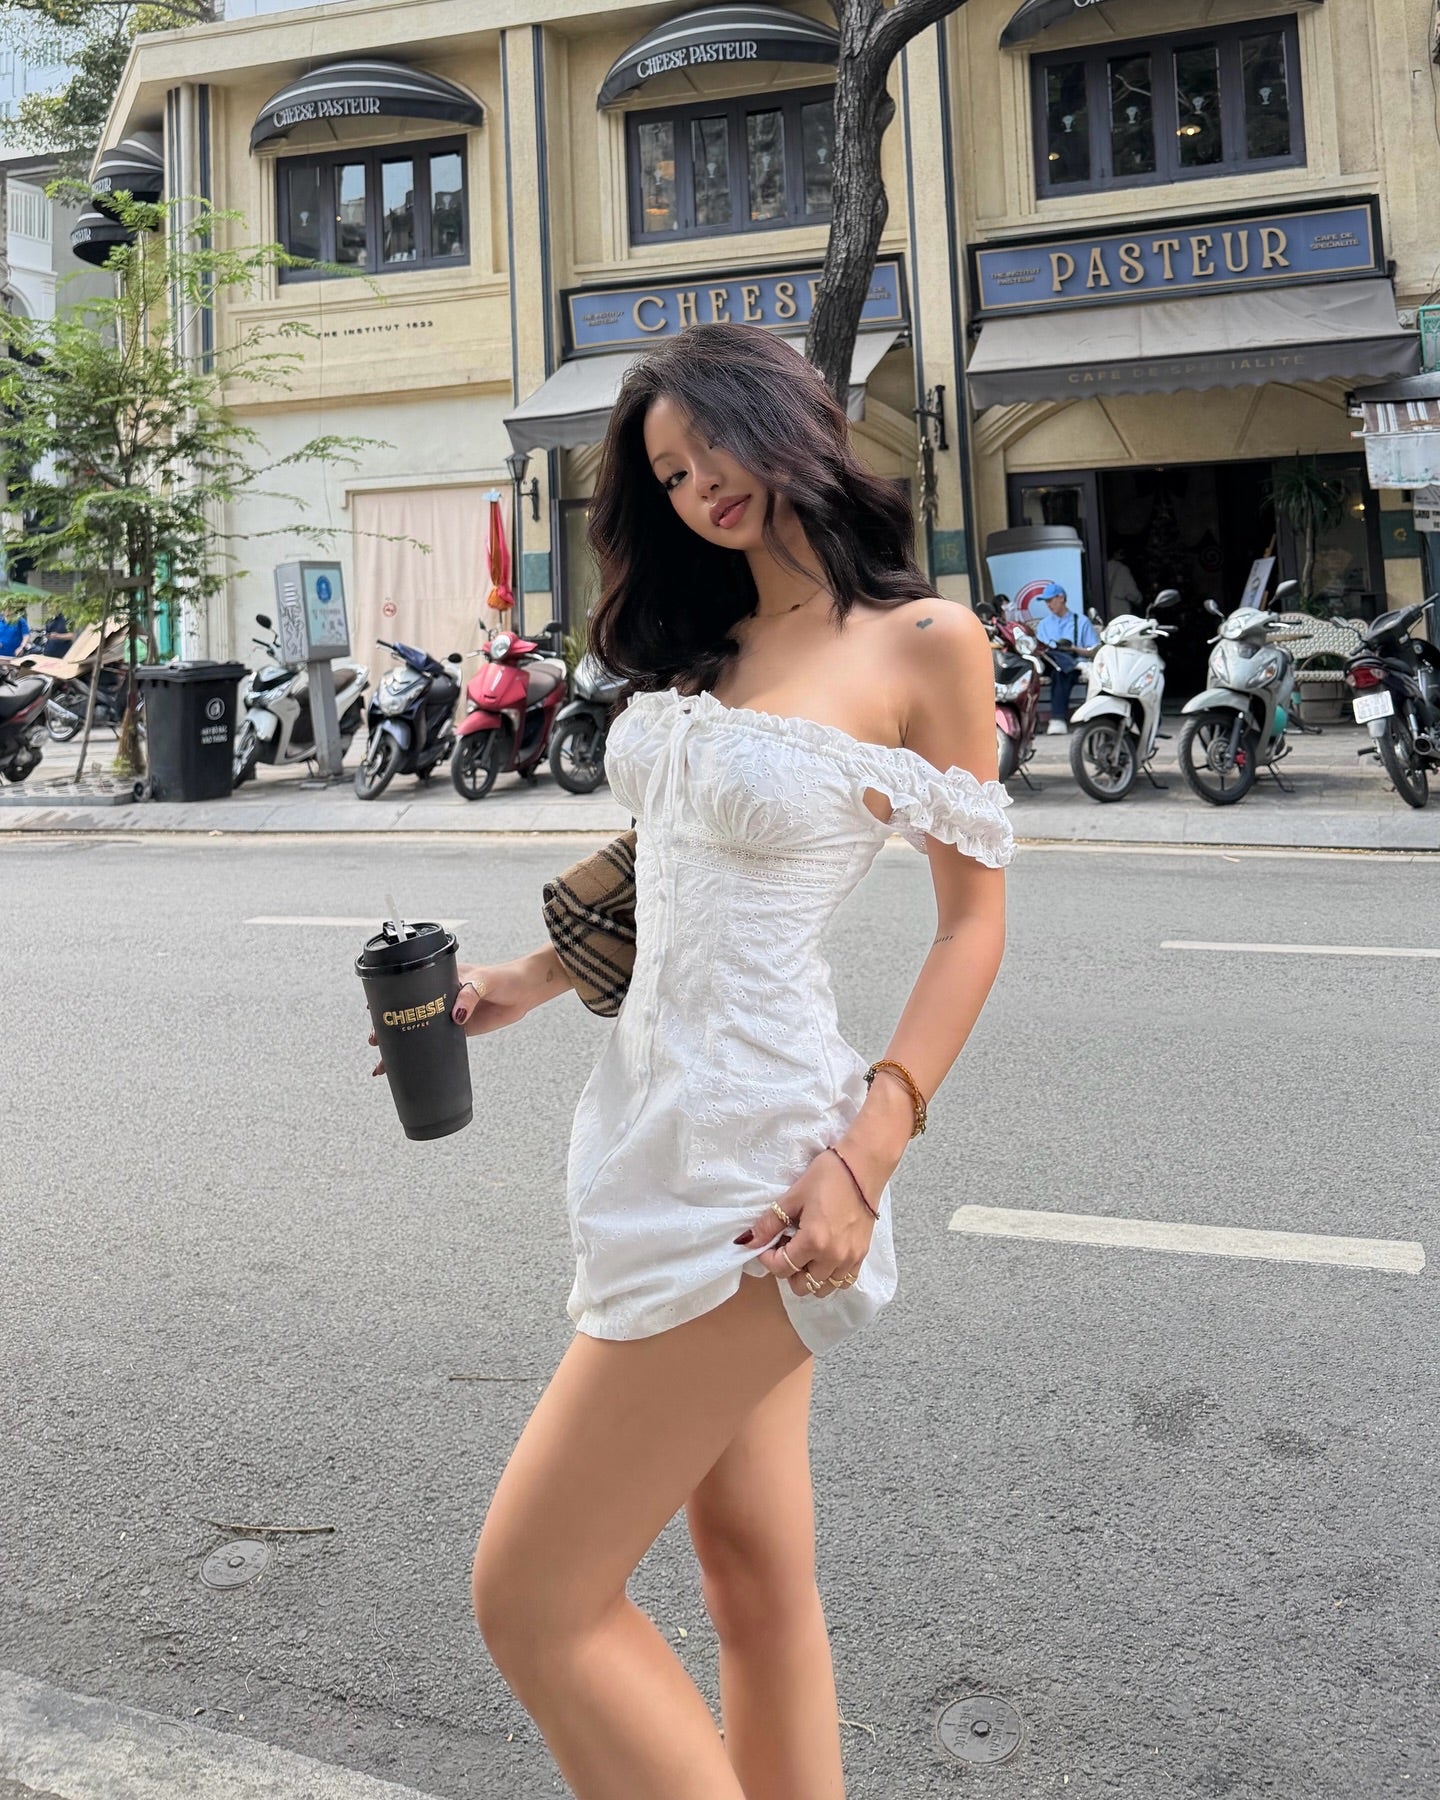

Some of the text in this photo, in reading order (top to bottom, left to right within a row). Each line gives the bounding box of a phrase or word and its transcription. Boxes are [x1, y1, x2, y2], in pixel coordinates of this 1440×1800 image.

[637, 41, 758, 78] CHEESE PASTEUR
[273, 97, 380, 128] CHEESE PASTEUR
[1049, 227, 1290, 292] PASTEUR
[344, 323, 400, 336] INSTITUT
[1132, 367, 1159, 378] DE
[383, 997, 446, 1026] CHEESE
[402, 1021, 430, 1032] COFFEE
